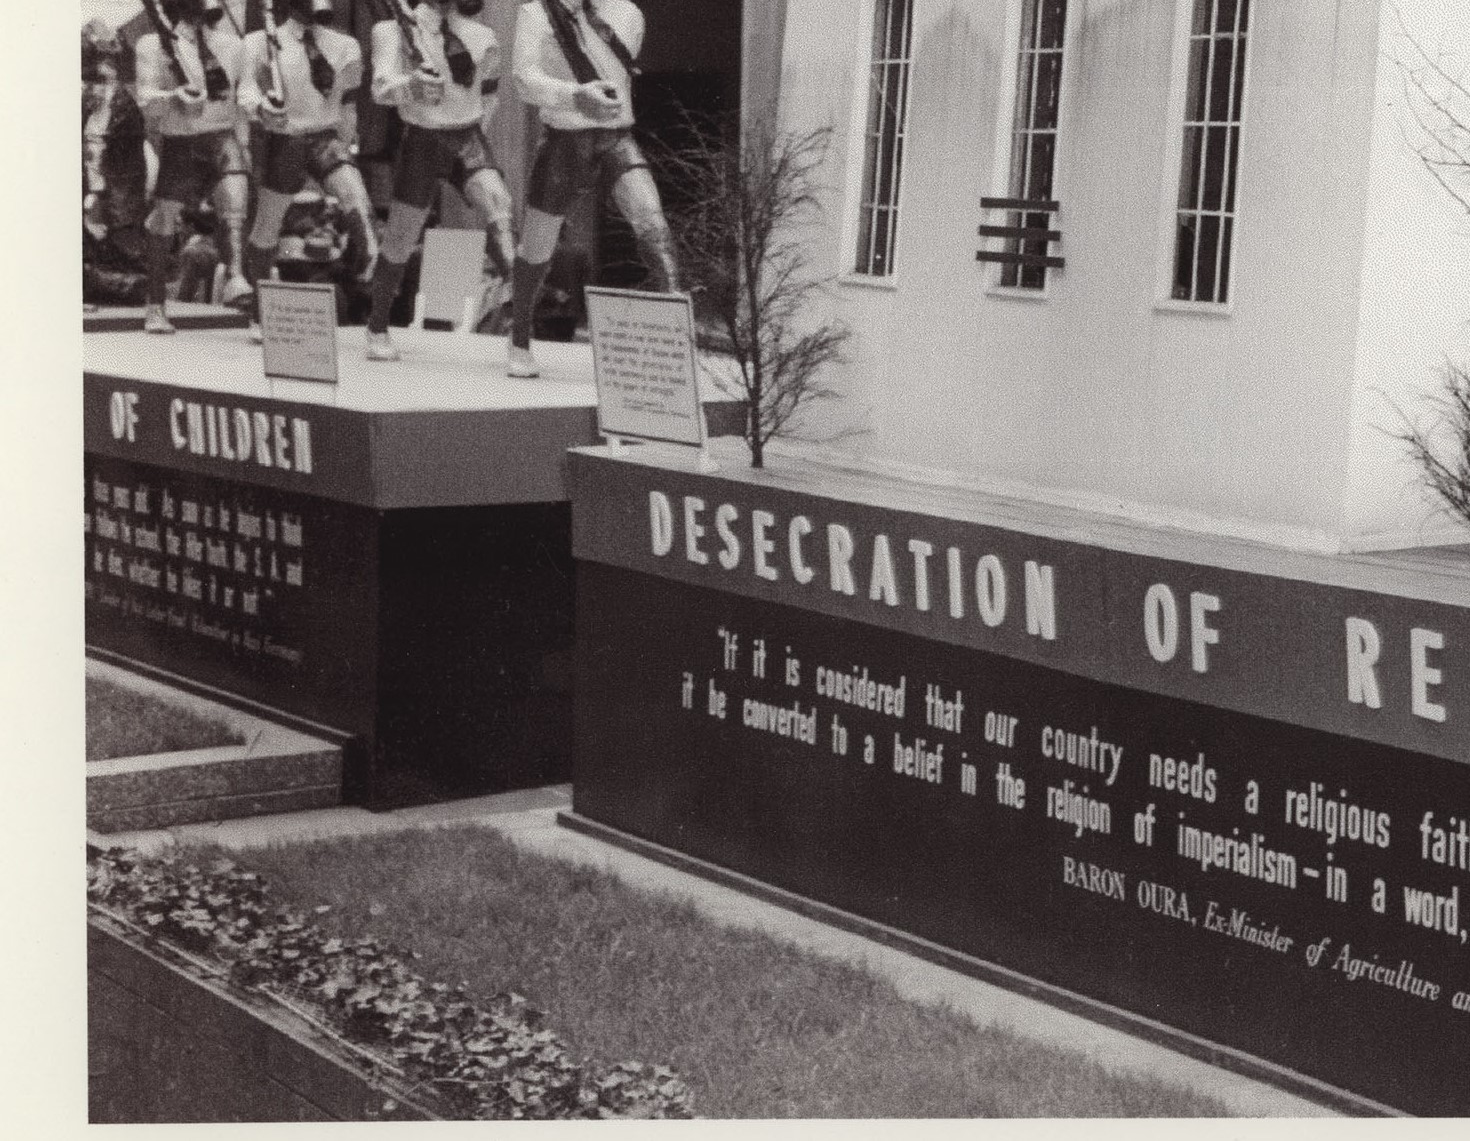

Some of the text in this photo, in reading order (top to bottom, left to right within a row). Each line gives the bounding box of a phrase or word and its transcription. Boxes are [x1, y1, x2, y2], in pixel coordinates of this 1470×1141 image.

[110, 391, 312, 474] OF CHILDREN
[648, 490, 1057, 641] DESECRATION
[1143, 583, 1221, 673] OF
[682, 671, 694, 709] it
[709, 678, 726, 719] be
[743, 696, 817, 746] converted
[831, 713, 848, 756] to
[864, 733, 875, 764] a
[893, 732, 944, 784] belief
[961, 751, 977, 796] in
[996, 762, 1026, 810] the
[1047, 779, 1111, 839] religion
[1134, 803, 1156, 847] of
[1372, 877, 1386, 914] a
[1404, 886, 1468, 944] word,
[753, 638, 767, 679] it
[786, 645, 800, 687] is
[816, 664, 906, 719] considered
[926, 683, 964, 734] that
[985, 710, 1019, 748] our
[1041, 725, 1124, 786] country
[1149, 752, 1217, 803] needs
[1245, 779, 1259, 815] a
[1285, 781, 1391, 848] religious
[1063, 856, 1126, 902] BARON
[1137, 879, 1197, 927] OURA,
[1204, 899, 1294, 955] Ex-Minister
[1306, 936, 1332, 967] of
[1332, 943, 1441, 1002] Agriculture
